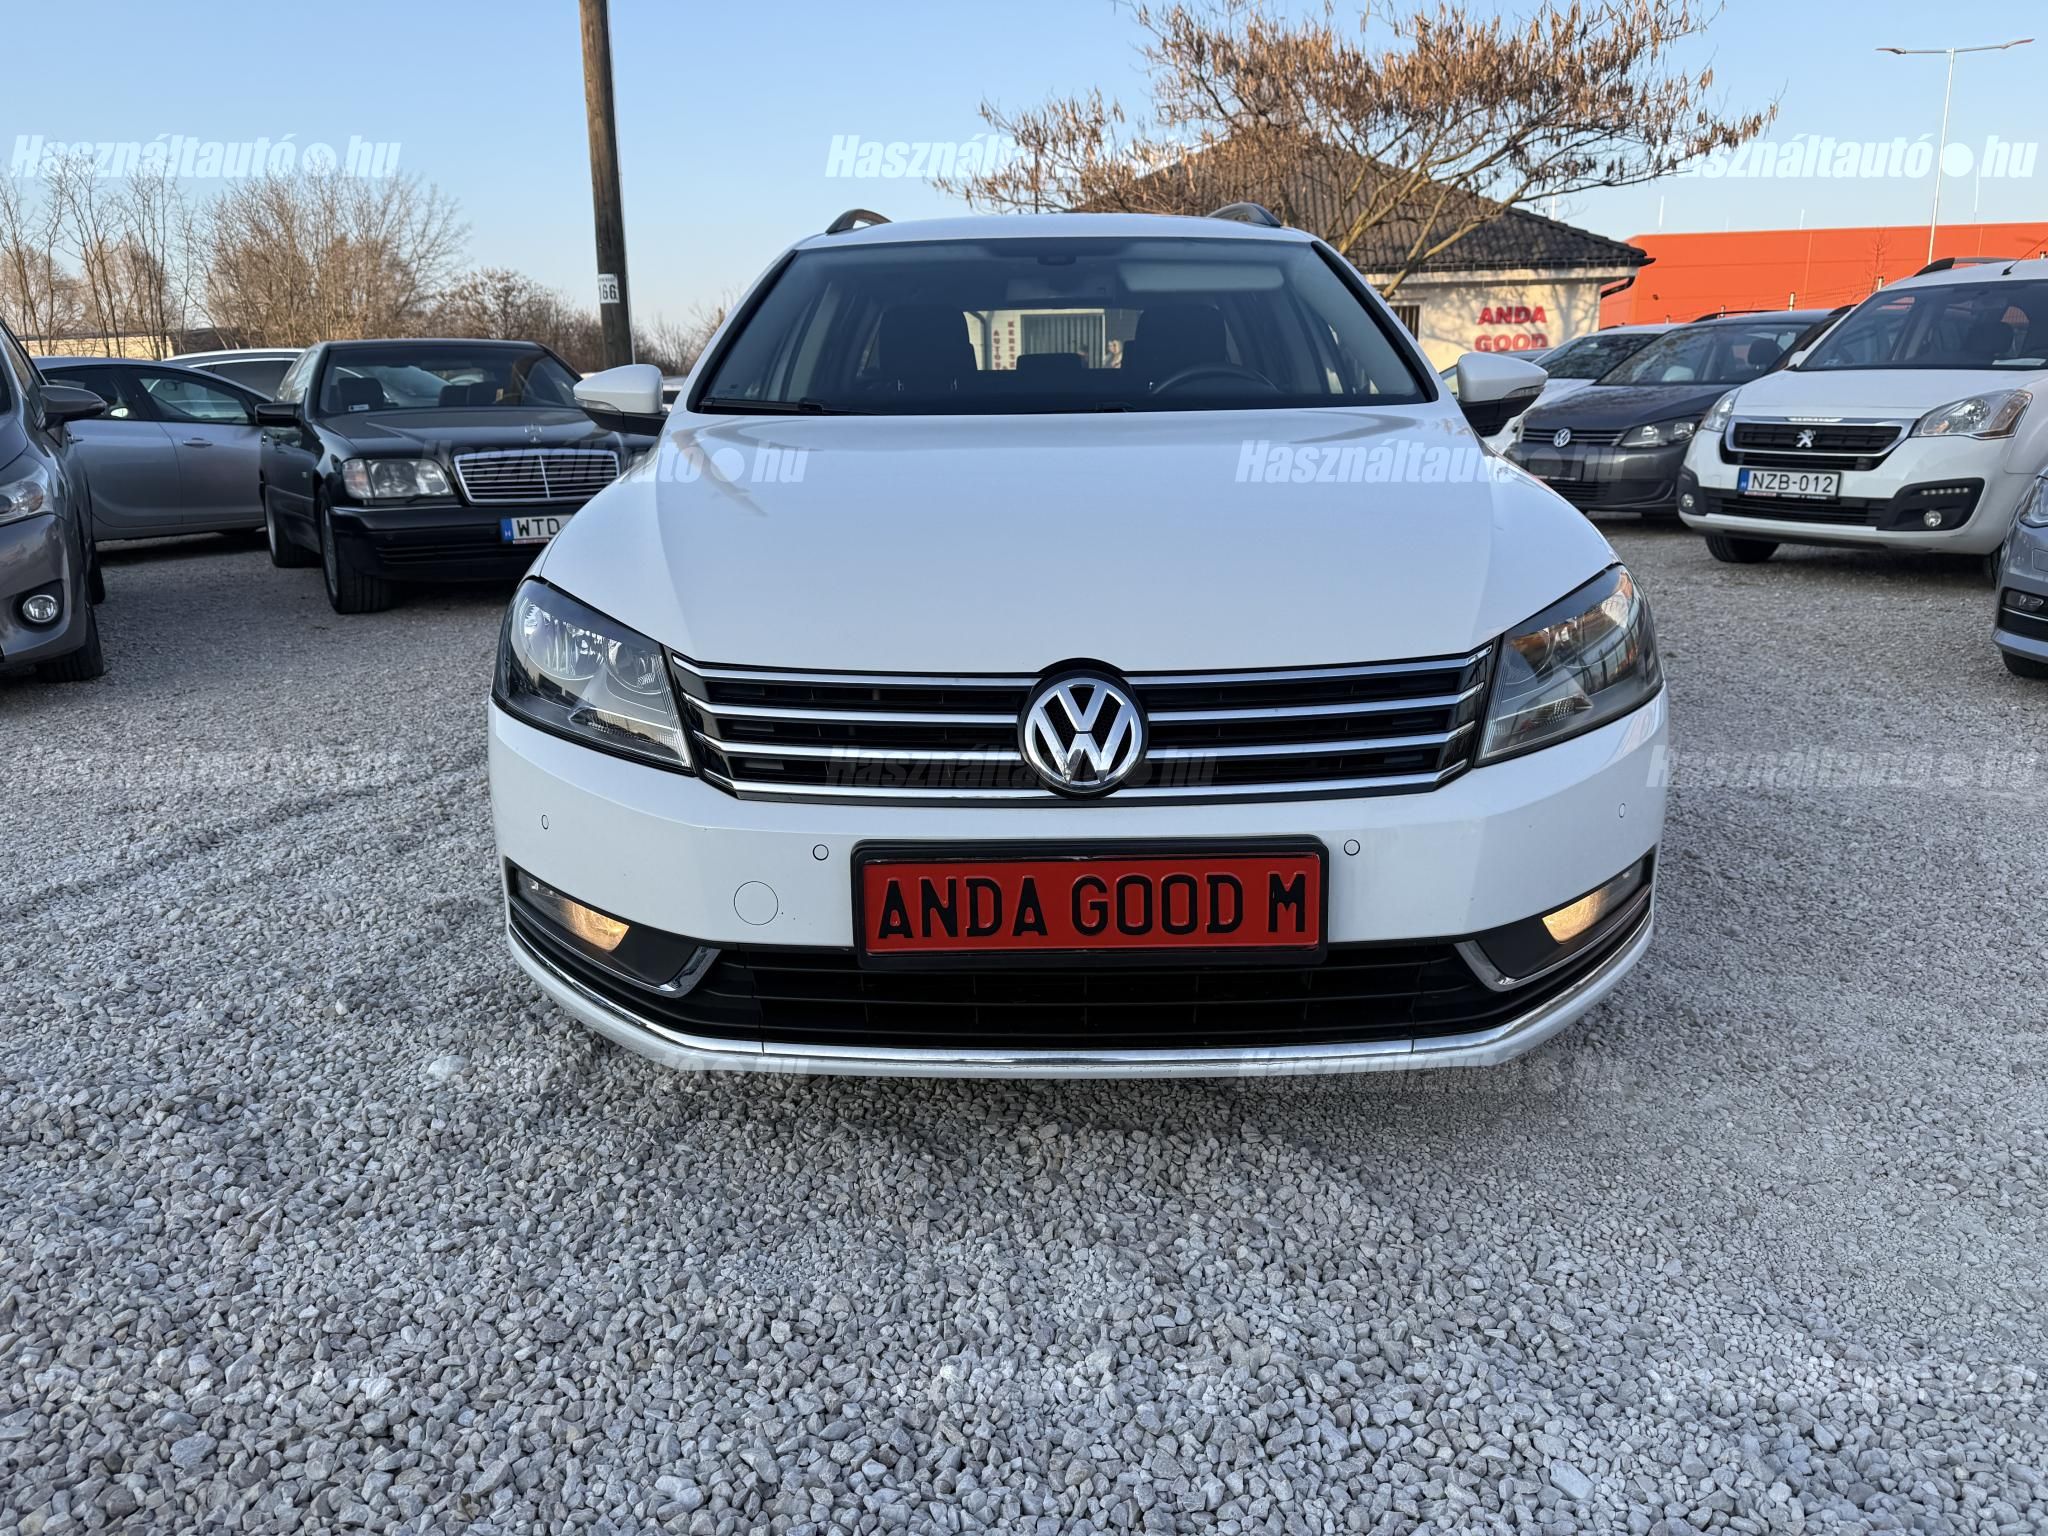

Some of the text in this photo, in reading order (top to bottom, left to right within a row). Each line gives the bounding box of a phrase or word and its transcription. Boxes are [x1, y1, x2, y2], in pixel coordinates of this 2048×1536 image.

[1477, 306, 1547, 325] ANDA
[1475, 333, 1548, 352] GOOD
[1751, 472, 1833, 493] NZB-012
[877, 872, 1307, 939] ANDA GOOD M
